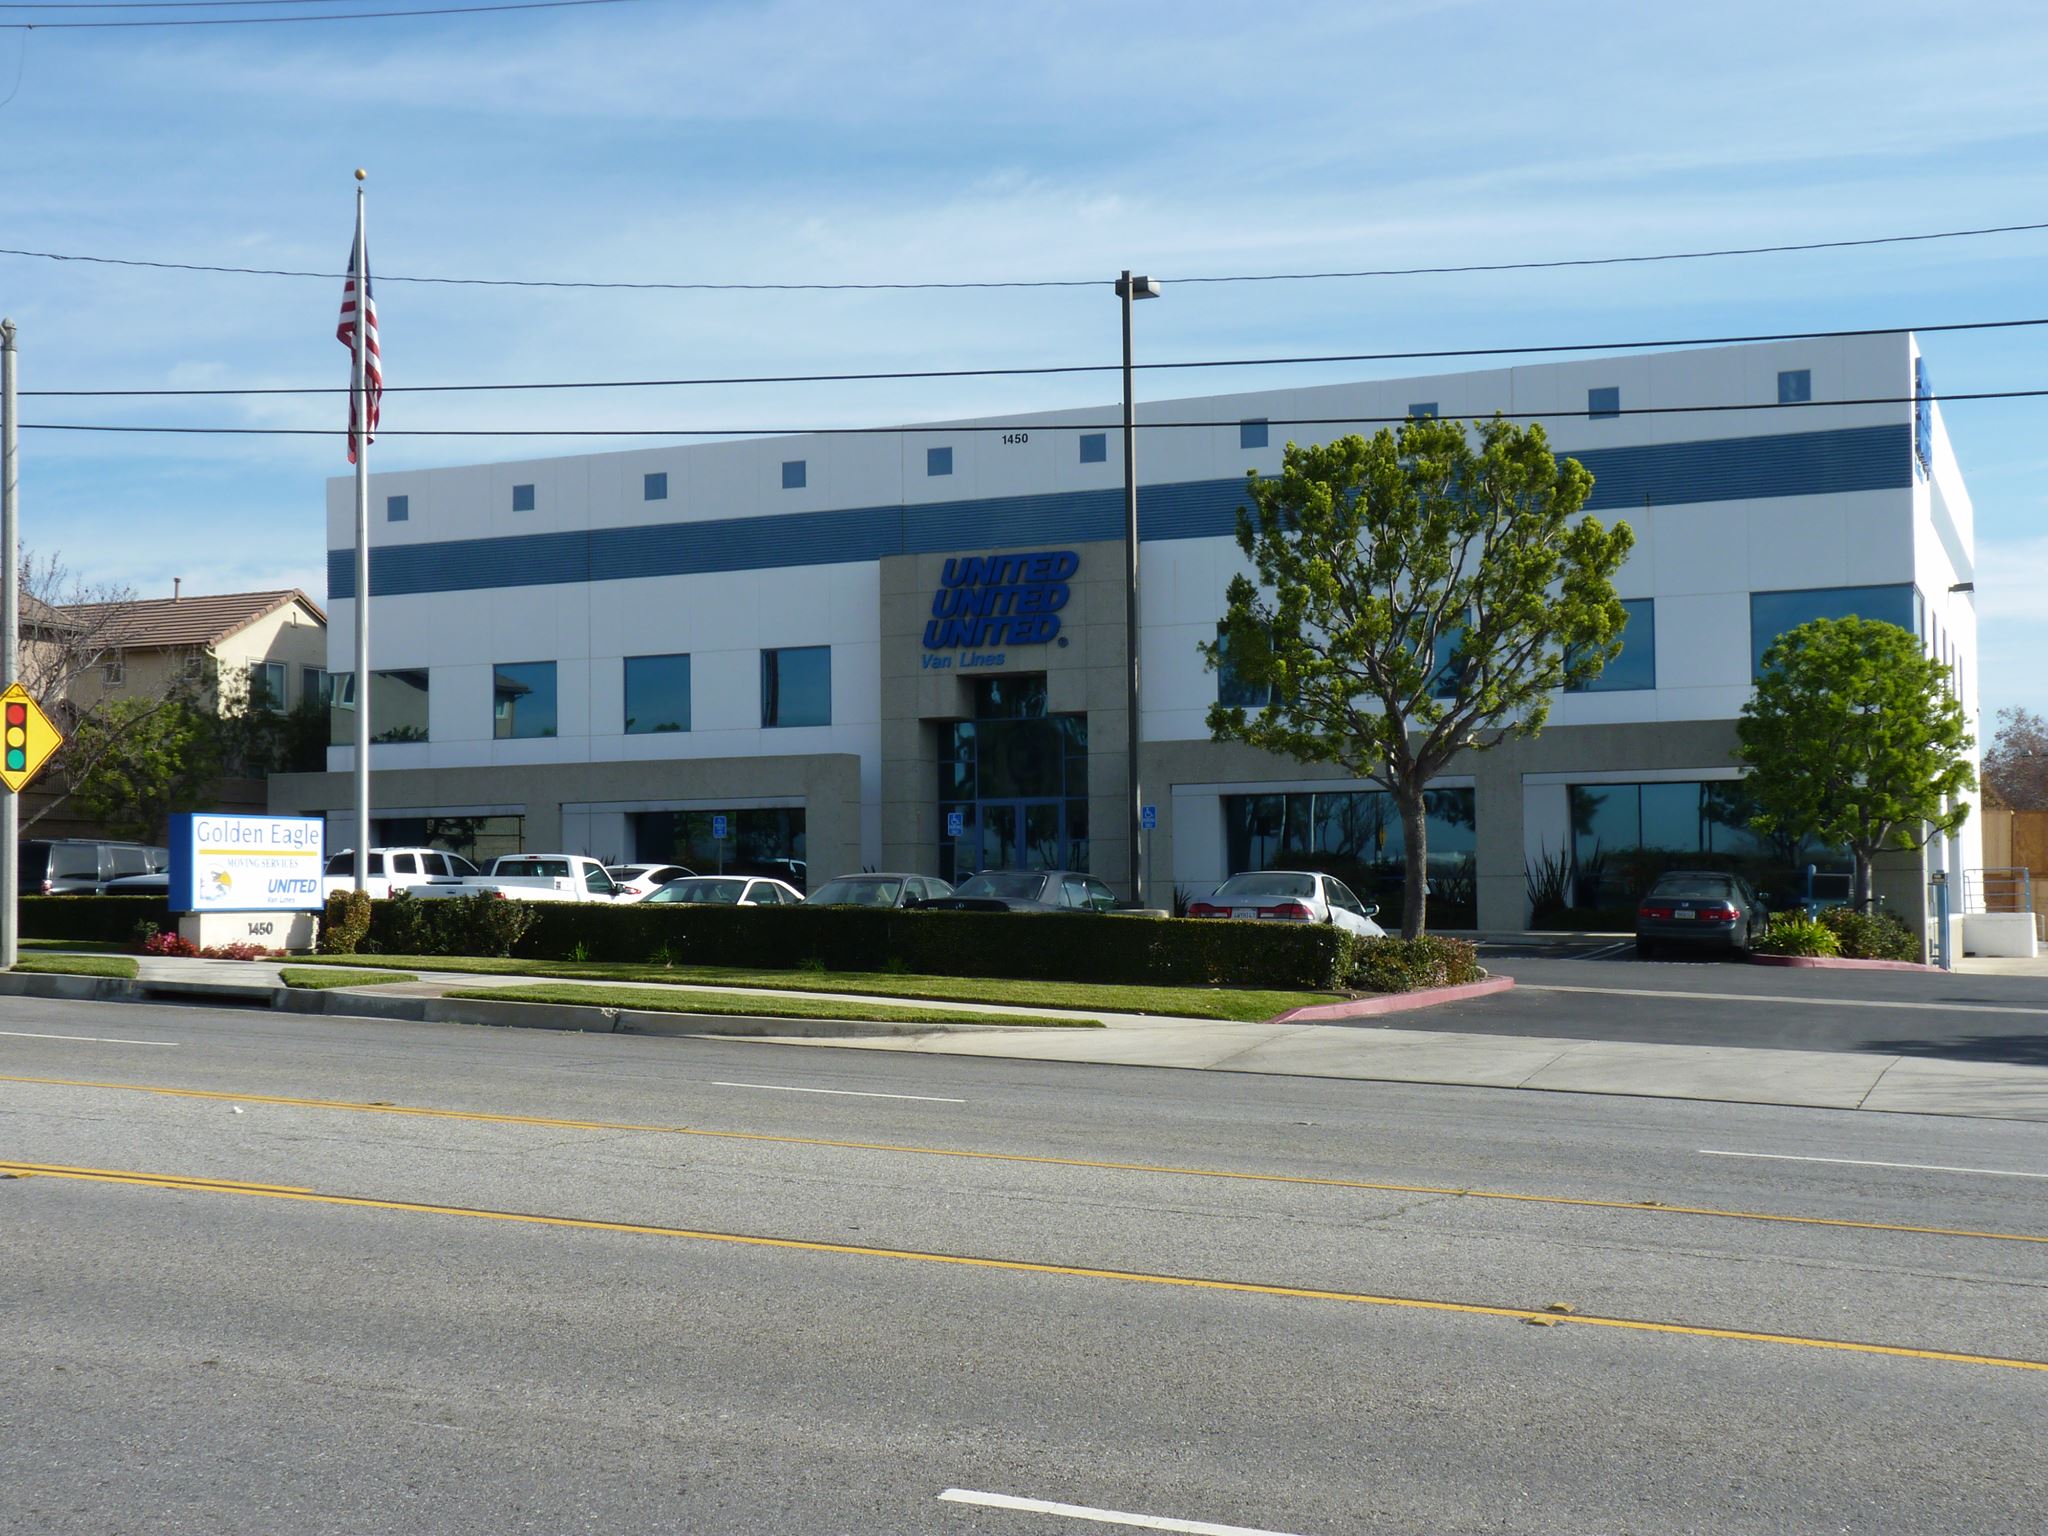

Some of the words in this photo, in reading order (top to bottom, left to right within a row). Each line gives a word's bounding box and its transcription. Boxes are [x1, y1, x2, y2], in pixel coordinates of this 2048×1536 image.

[1002, 433, 1029, 445] 1450
[941, 551, 1080, 588] UNITED
[931, 582, 1070, 619] UNITED
[922, 613, 1062, 650] UNITED
[922, 653, 951, 669] Van
[959, 651, 1005, 668] Lines
[197, 820, 263, 844] Golden
[271, 823, 319, 850] Eagle
[227, 857, 260, 869] MOVING
[261, 858, 299, 869] SERVICES
[268, 879, 318, 894] UNITED
[248, 922, 274, 936] 1450
